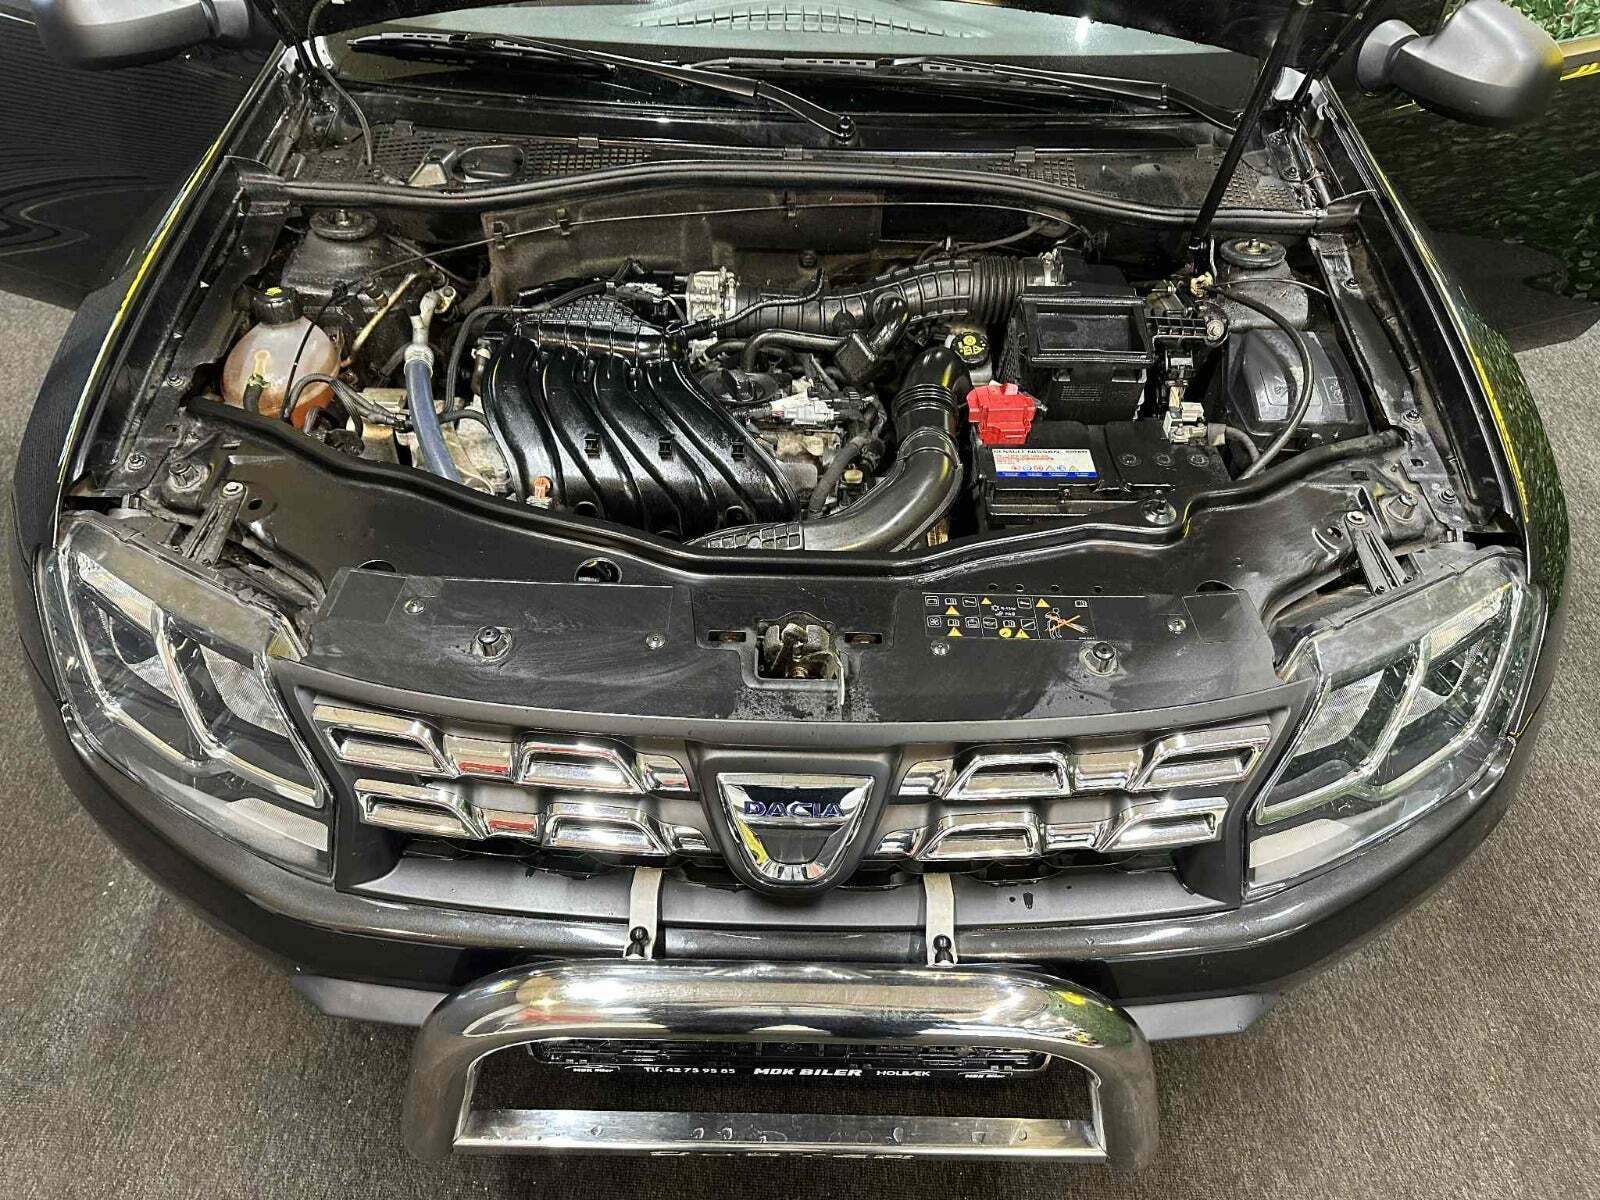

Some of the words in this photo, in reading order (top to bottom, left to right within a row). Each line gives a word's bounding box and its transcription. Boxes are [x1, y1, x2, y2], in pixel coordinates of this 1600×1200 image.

[743, 800, 844, 818] DACIA
[753, 1067, 795, 1076] MDK
[798, 1068, 863, 1077] BILER
